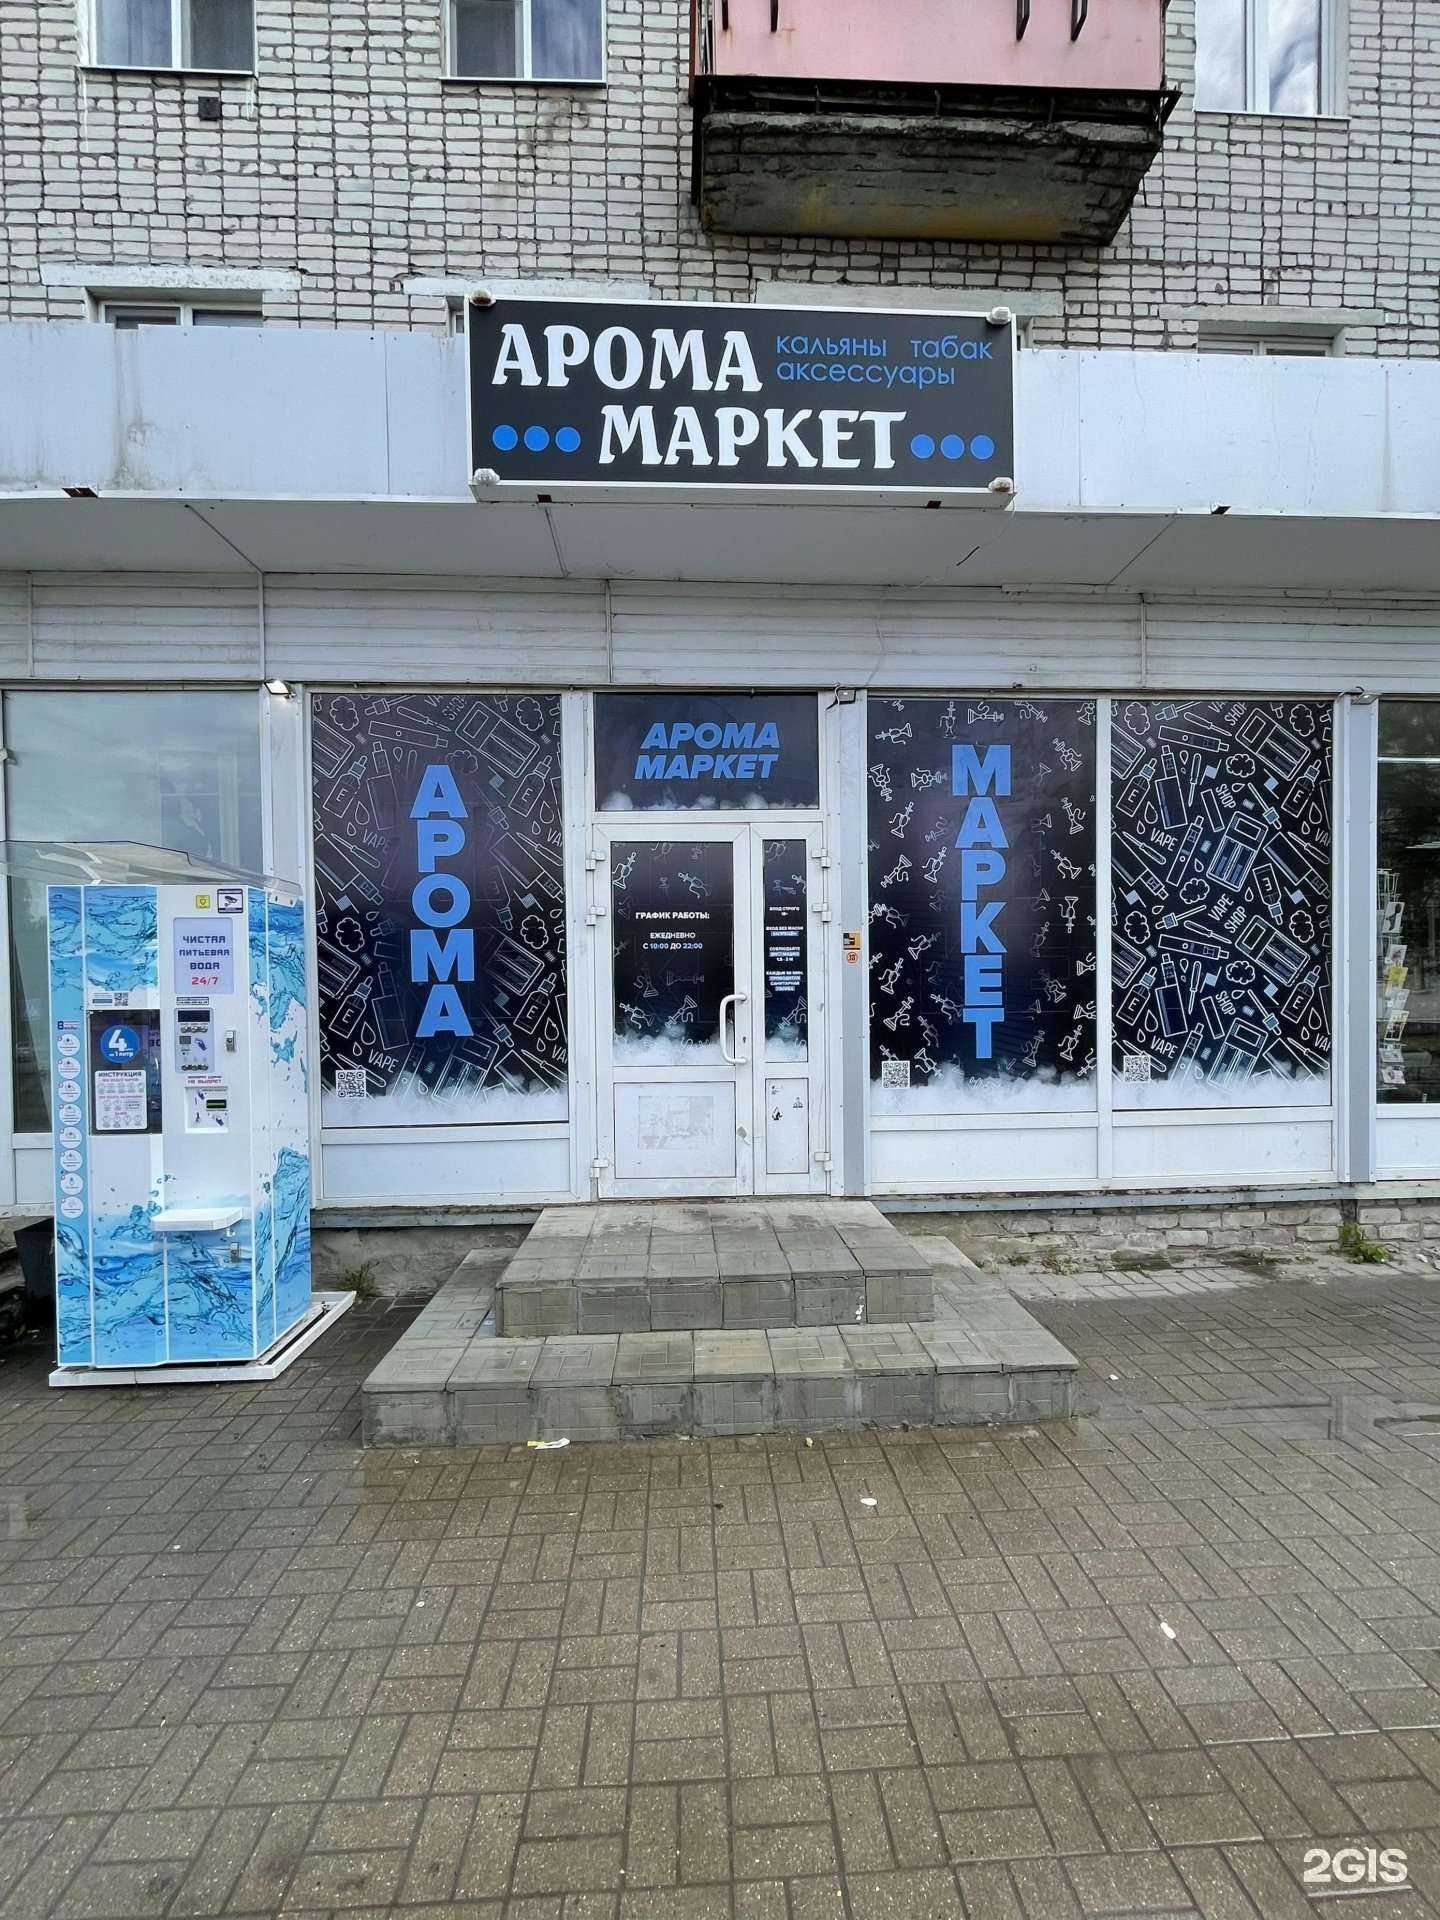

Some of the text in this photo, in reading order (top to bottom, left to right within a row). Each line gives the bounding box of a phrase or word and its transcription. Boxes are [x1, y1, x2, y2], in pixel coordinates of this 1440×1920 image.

[492, 323, 763, 392] АРОМА
[776, 335, 993, 360] кальяны табак
[777, 361, 955, 389] аксессуары
[598, 404, 907, 469] МАРКЕТ
[640, 722, 780, 749] АРОМА
[633, 754, 779, 779] МАРКЕТ
[1215, 783, 1236, 809] SHOP
[1151, 828, 1178, 851] VAPE
[409, 764, 475, 1037] АРОМА
[952, 745, 1011, 1058] МАРКЕТ
[1208, 894, 1234, 921] VAPE
[635, 911, 710, 919] ГРАФИК РАБОТЫ:
[1224, 906, 1248, 933] SHOP
[190, 962, 220, 970] ВОДА
[191, 977, 218, 985] 24/7
[1215, 990, 1236, 1016] SHOP
[109, 1029, 127, 1051] 4
[1151, 1035, 1178, 1059] VAPE
[368, 1049, 399, 1073] VAPE
